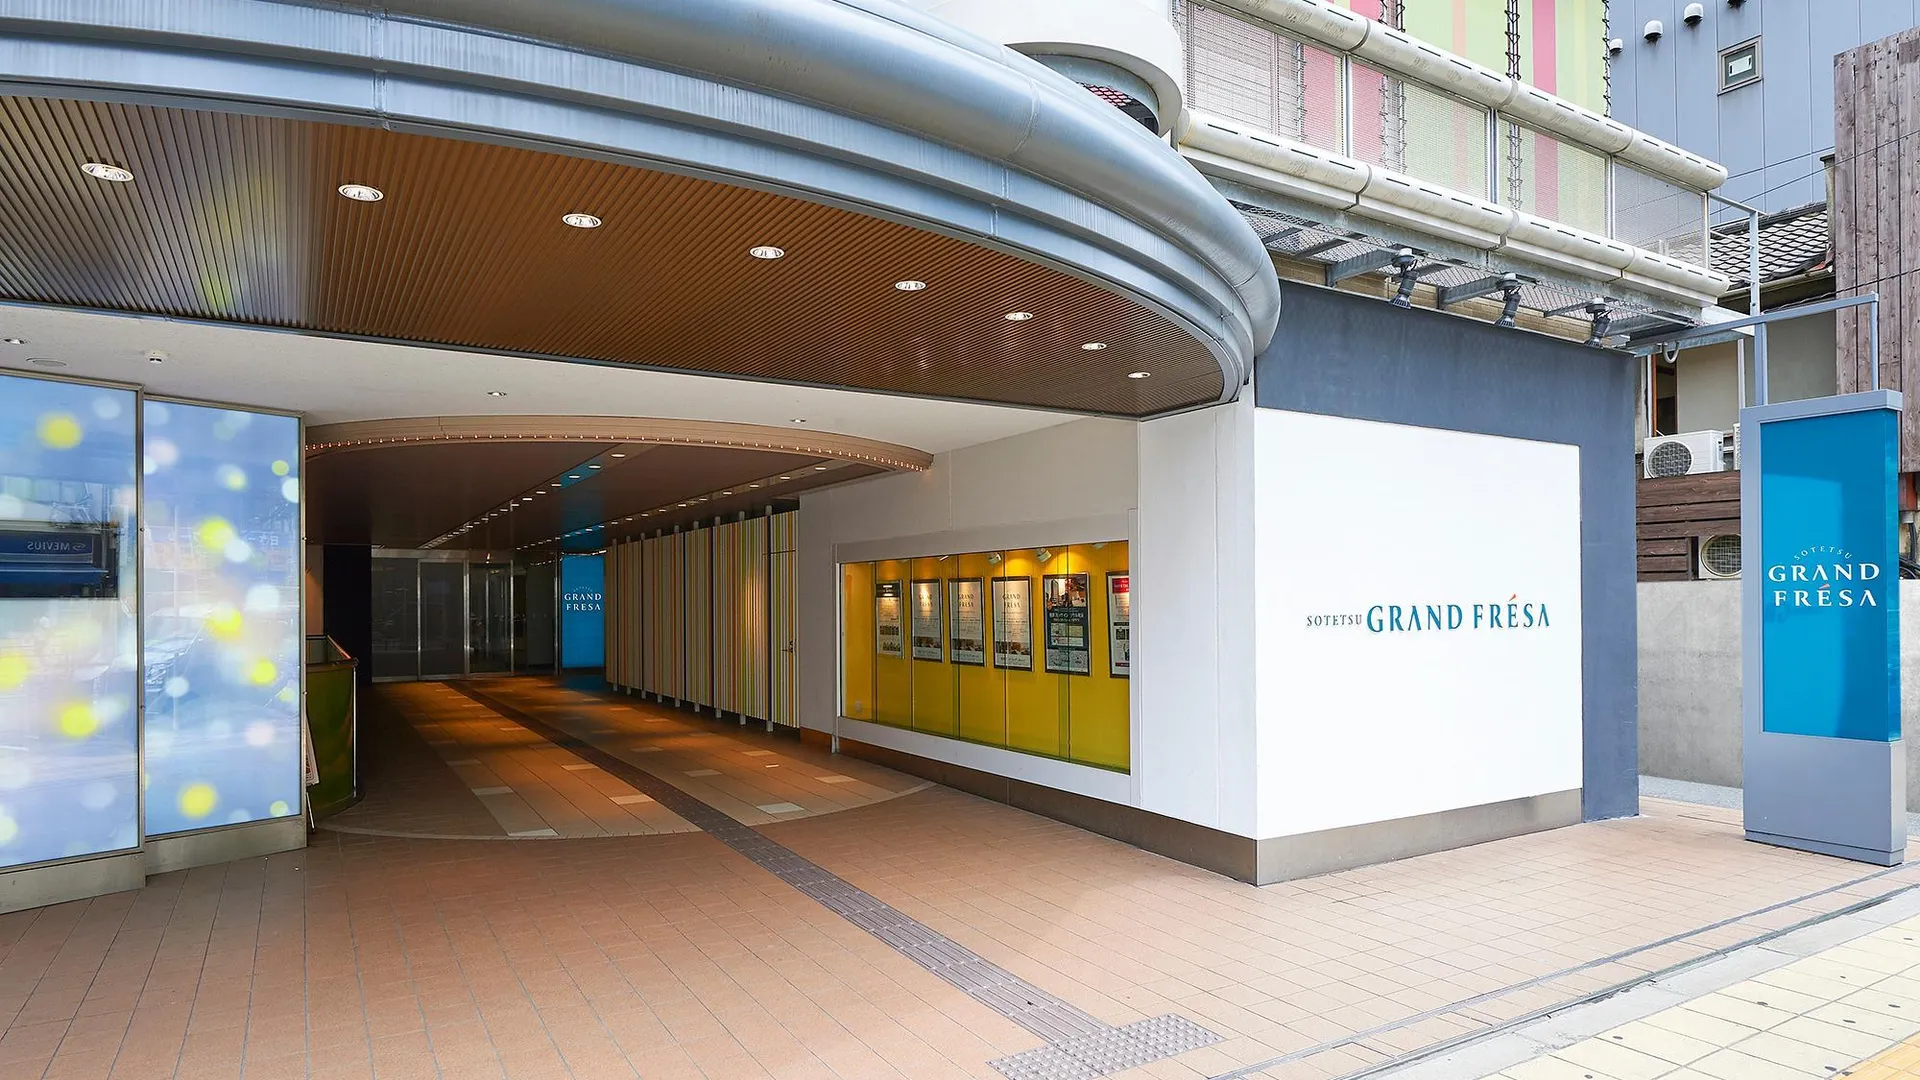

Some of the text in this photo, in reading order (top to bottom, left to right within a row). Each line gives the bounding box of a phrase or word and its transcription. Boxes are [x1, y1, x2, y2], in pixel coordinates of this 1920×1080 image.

[1793, 545, 1852, 560] SOTETSU
[1768, 563, 1880, 582] GRAND
[564, 593, 602, 601] GRAND
[1773, 583, 1877, 607] FRÉSA
[1306, 593, 1550, 633] SOTETSU GRAND FRÉSA
